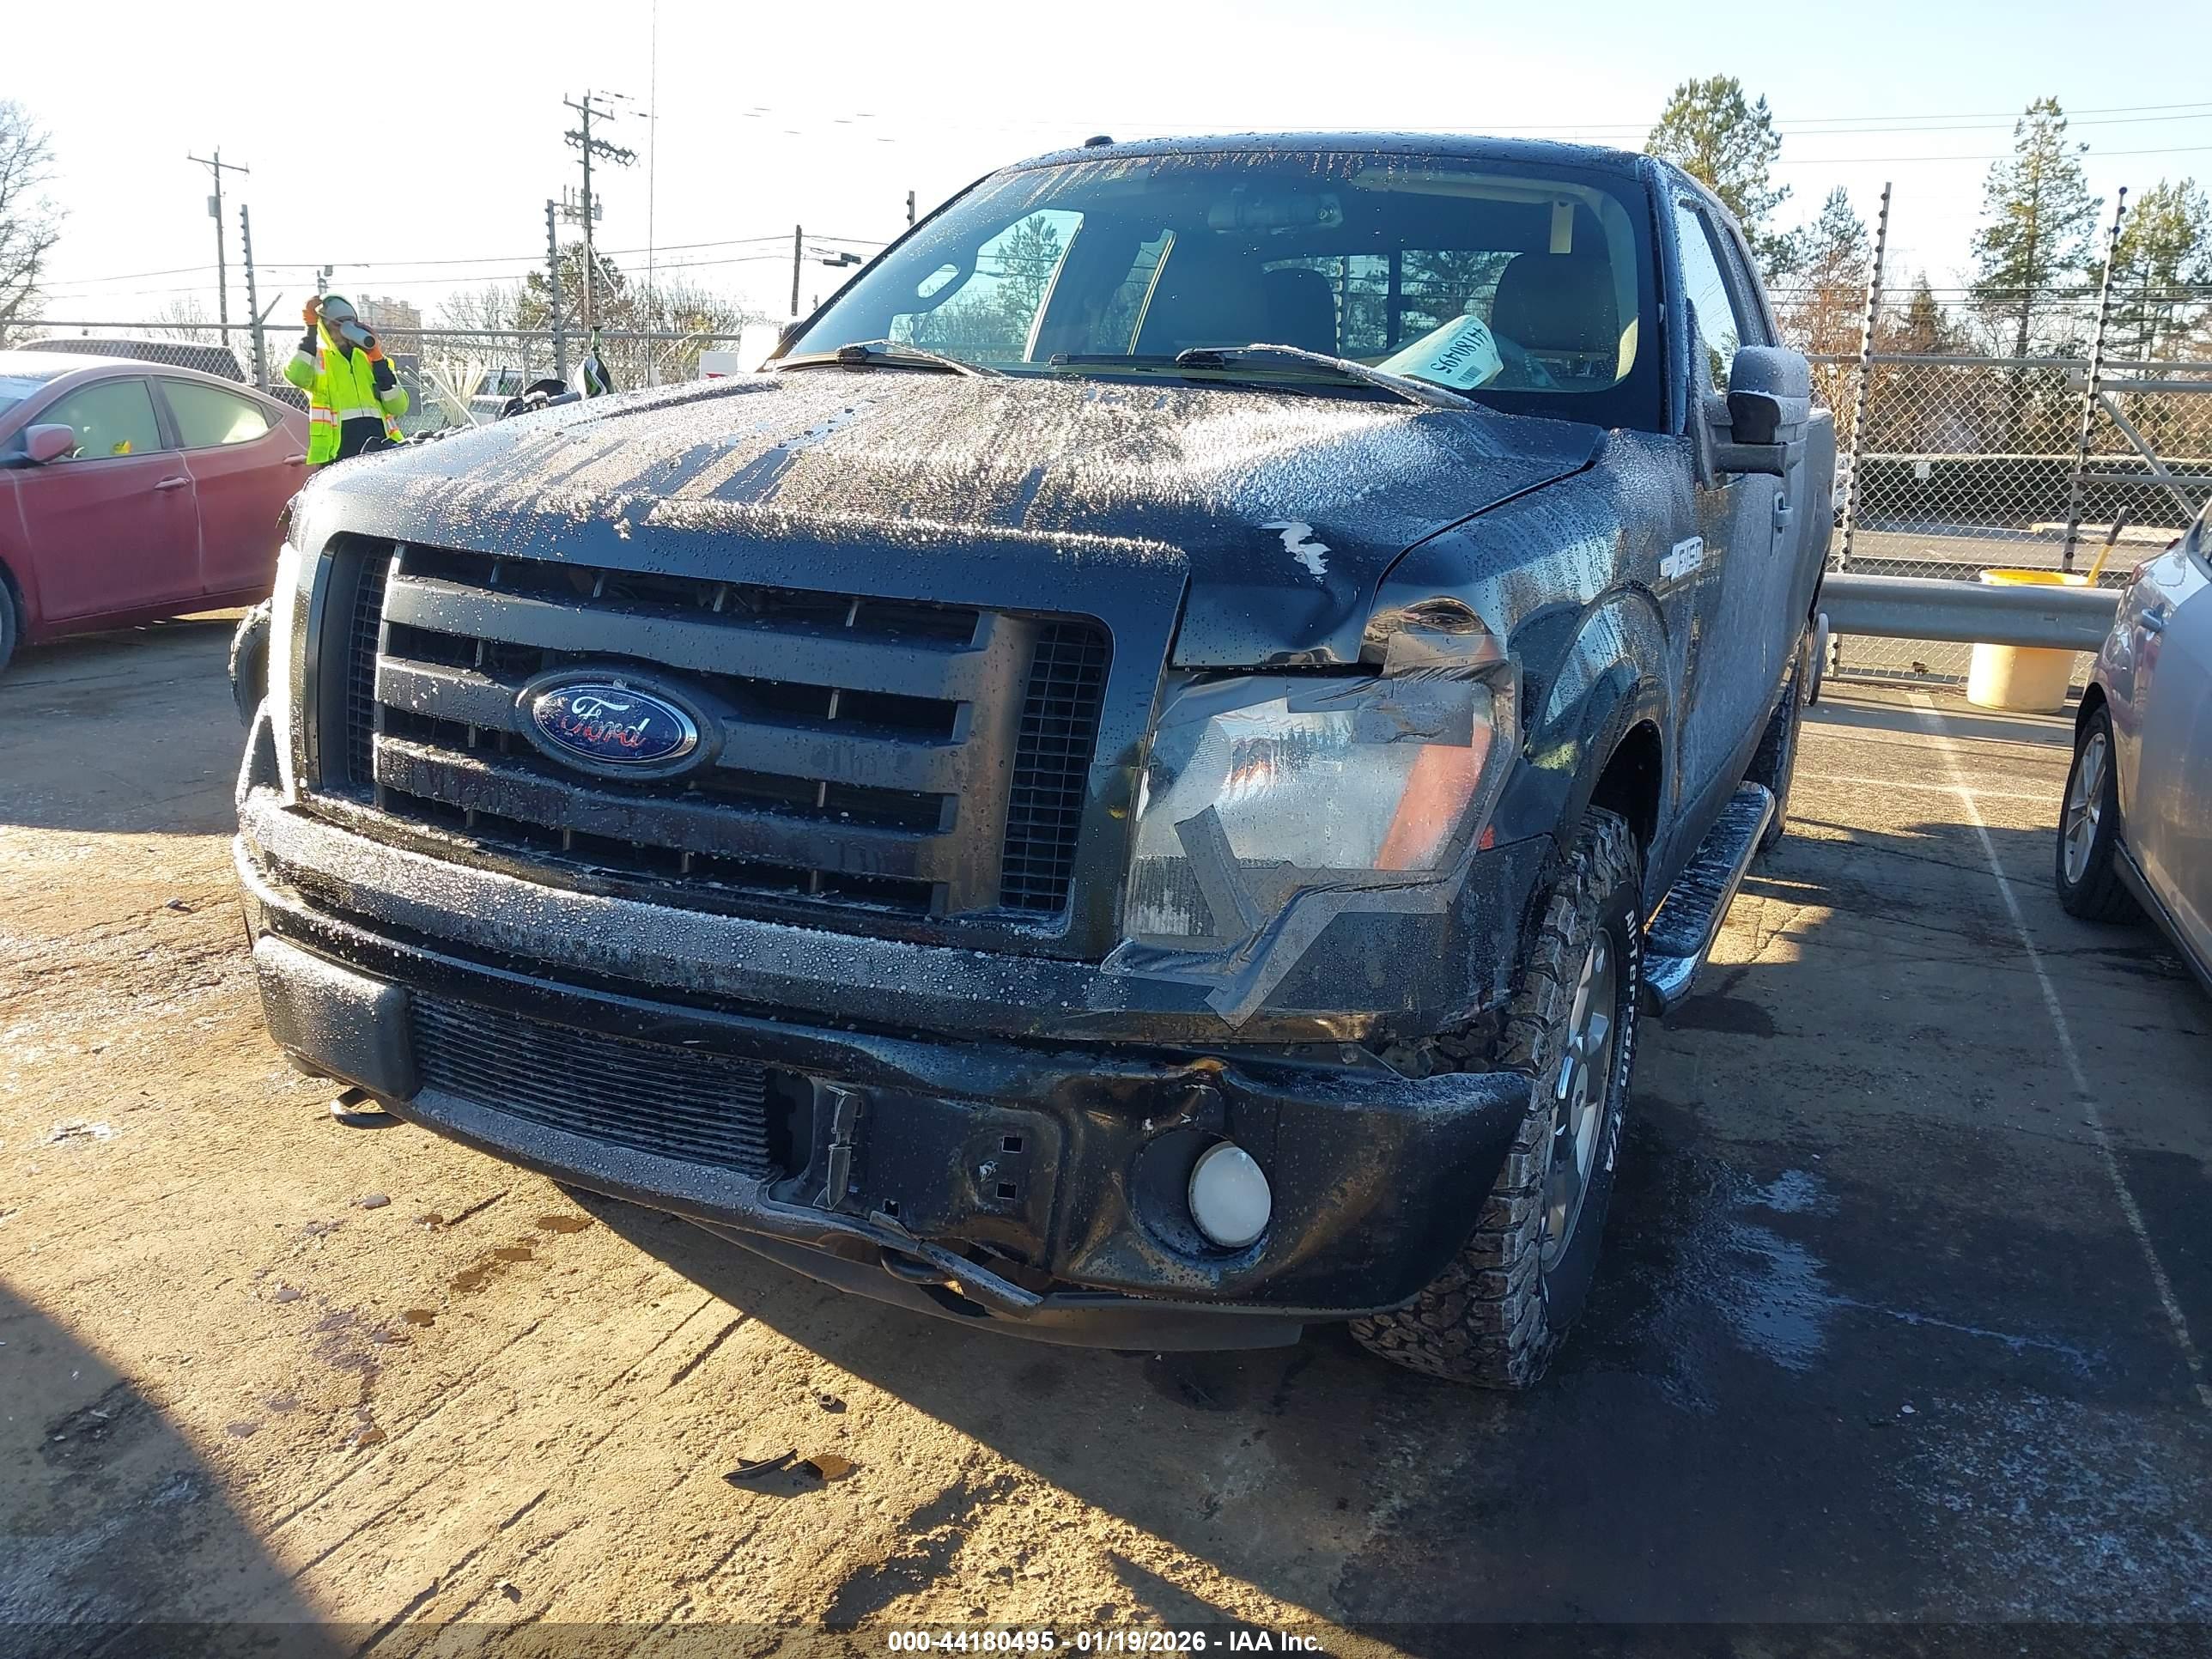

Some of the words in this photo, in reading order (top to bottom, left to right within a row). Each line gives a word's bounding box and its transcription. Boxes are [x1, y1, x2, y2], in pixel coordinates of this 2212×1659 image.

[1430, 327, 1488, 374] 44180495
[561, 696, 650, 748] Ford
[1620, 909, 1638, 1087] All-Terrain
[1606, 1111, 1623, 1172] T/A
